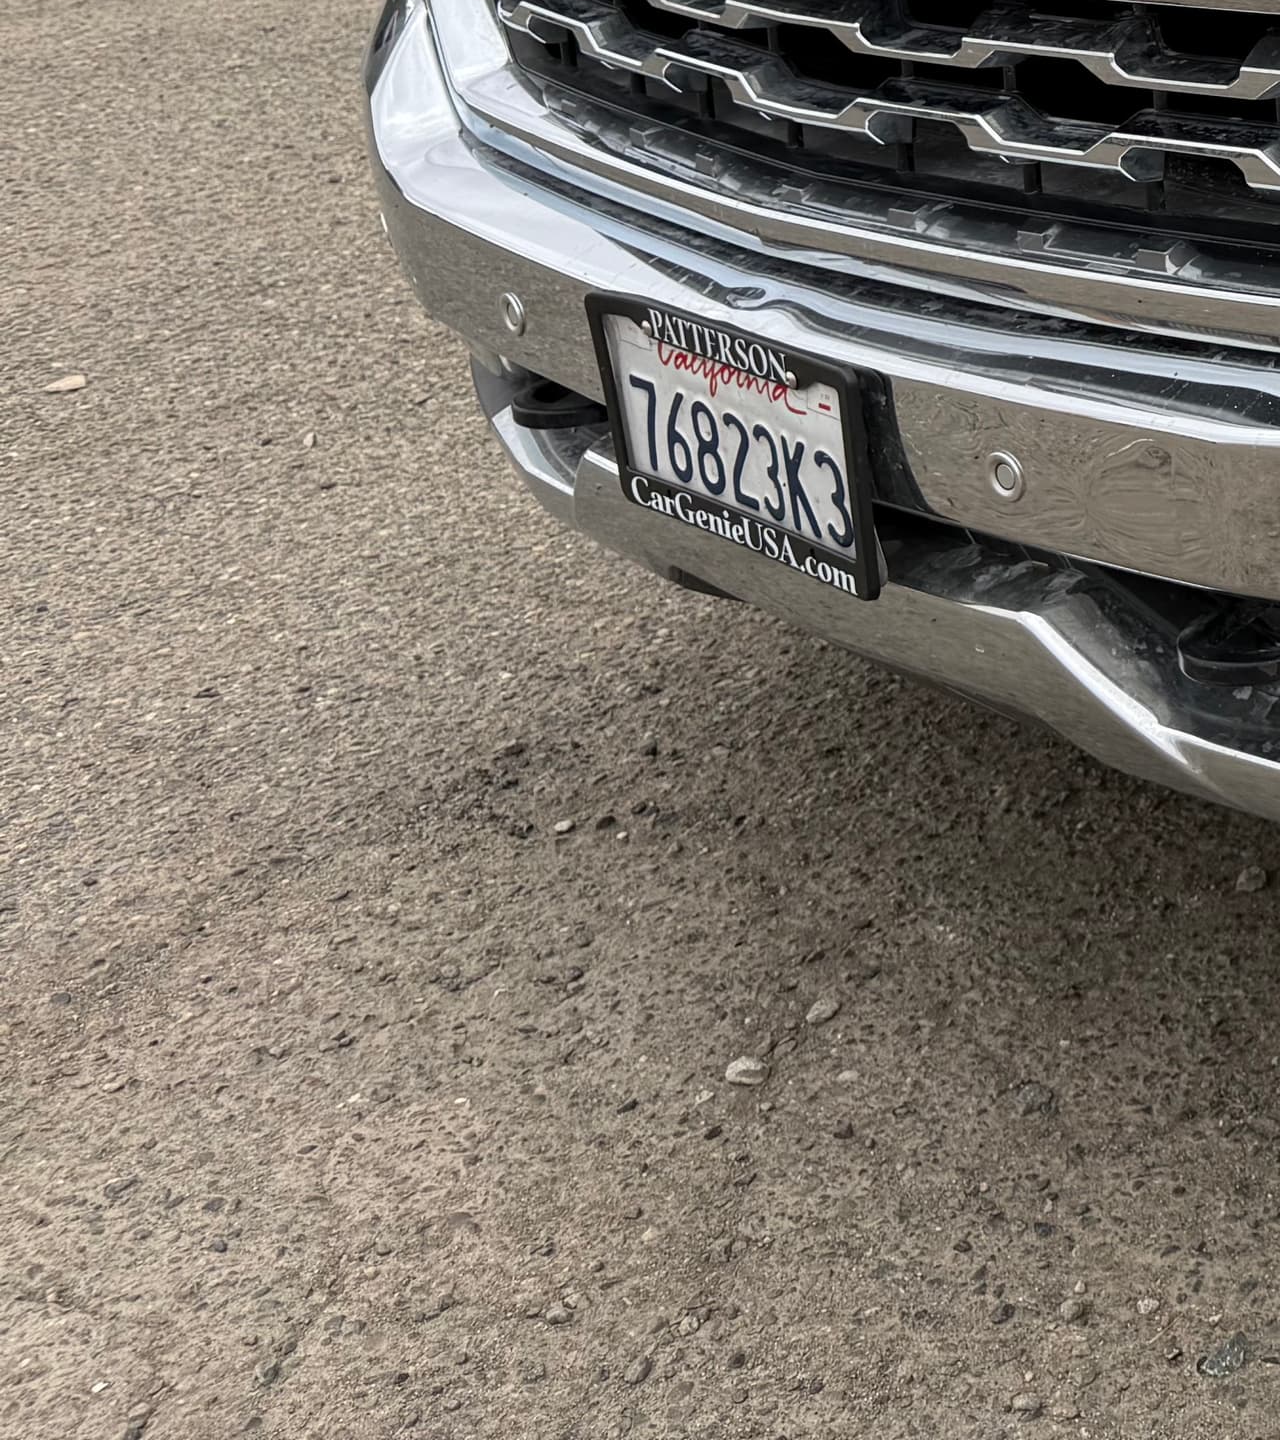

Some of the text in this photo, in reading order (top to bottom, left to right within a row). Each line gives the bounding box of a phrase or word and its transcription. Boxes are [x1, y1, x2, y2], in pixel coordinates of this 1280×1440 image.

[648, 308, 789, 385] PATTERSON
[629, 374, 854, 547] 76823K3
[631, 475, 858, 596] CarGenieUSA.com
